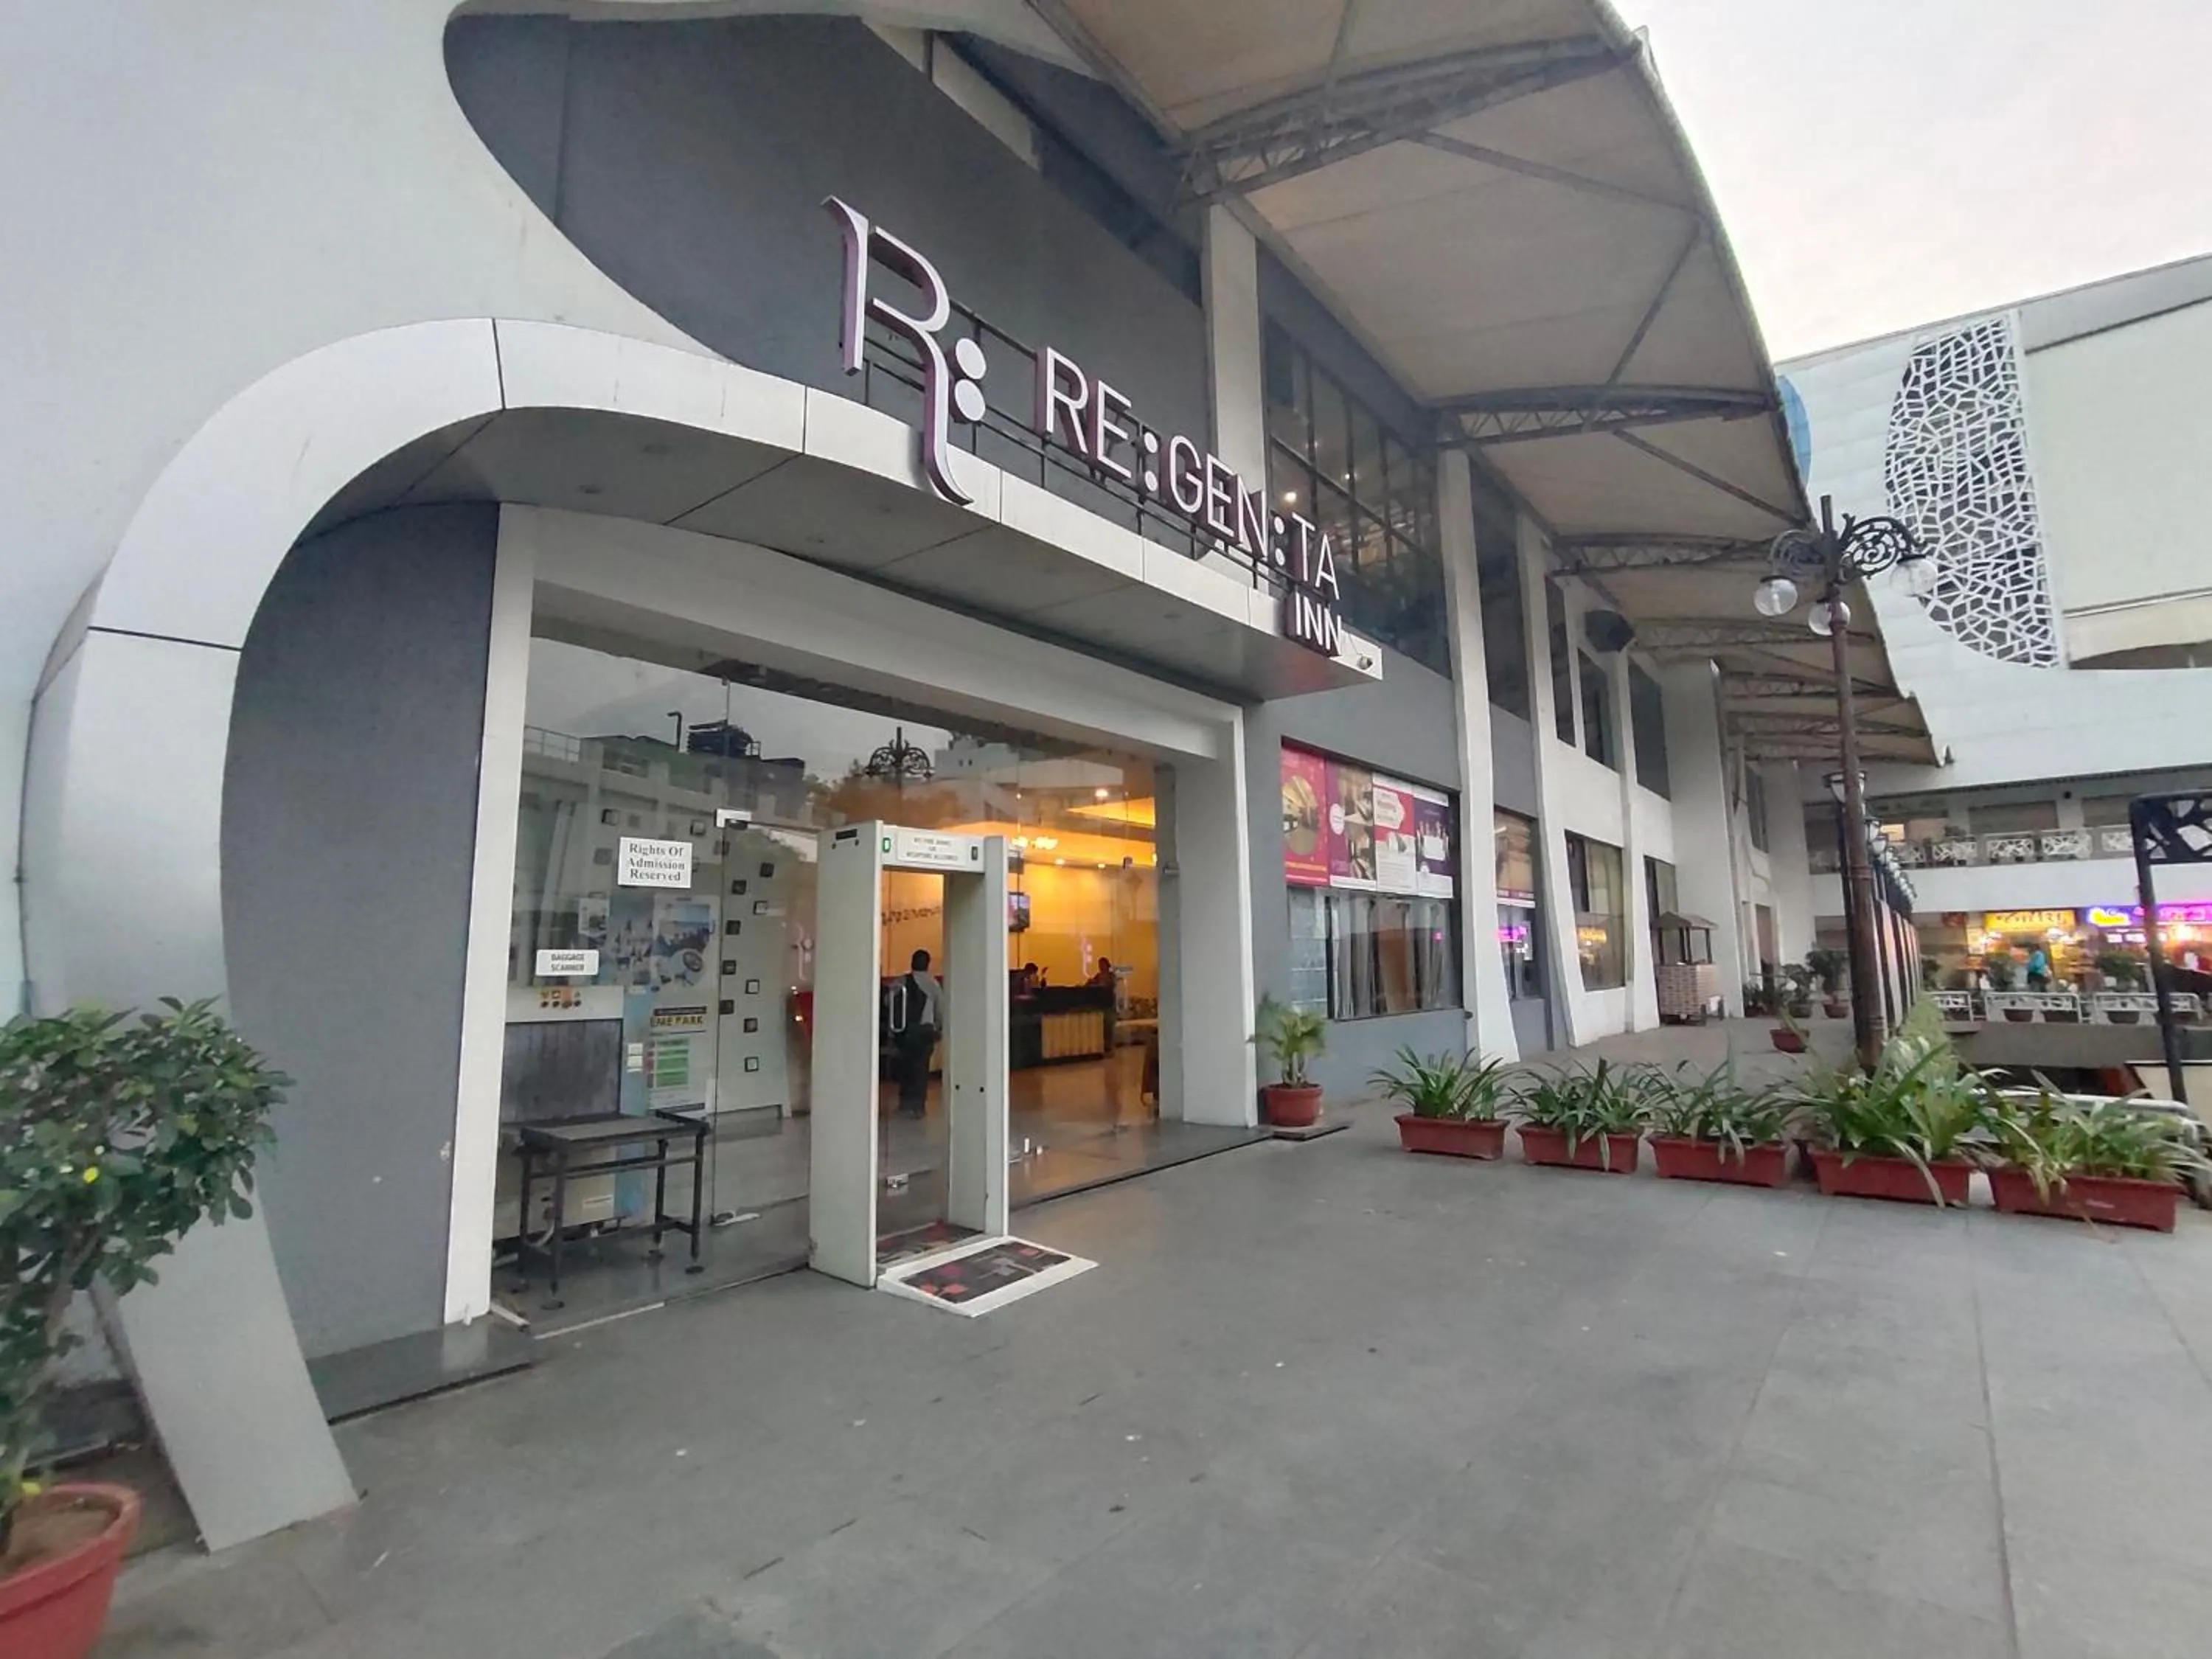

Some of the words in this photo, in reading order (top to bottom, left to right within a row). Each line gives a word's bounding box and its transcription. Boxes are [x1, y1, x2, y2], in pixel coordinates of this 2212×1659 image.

[1292, 591, 1341, 655] INN
[628, 843, 666, 856] Rights
[669, 846, 685, 857] Of
[629, 858, 686, 870] Admission
[630, 868, 682, 882] Reserved
